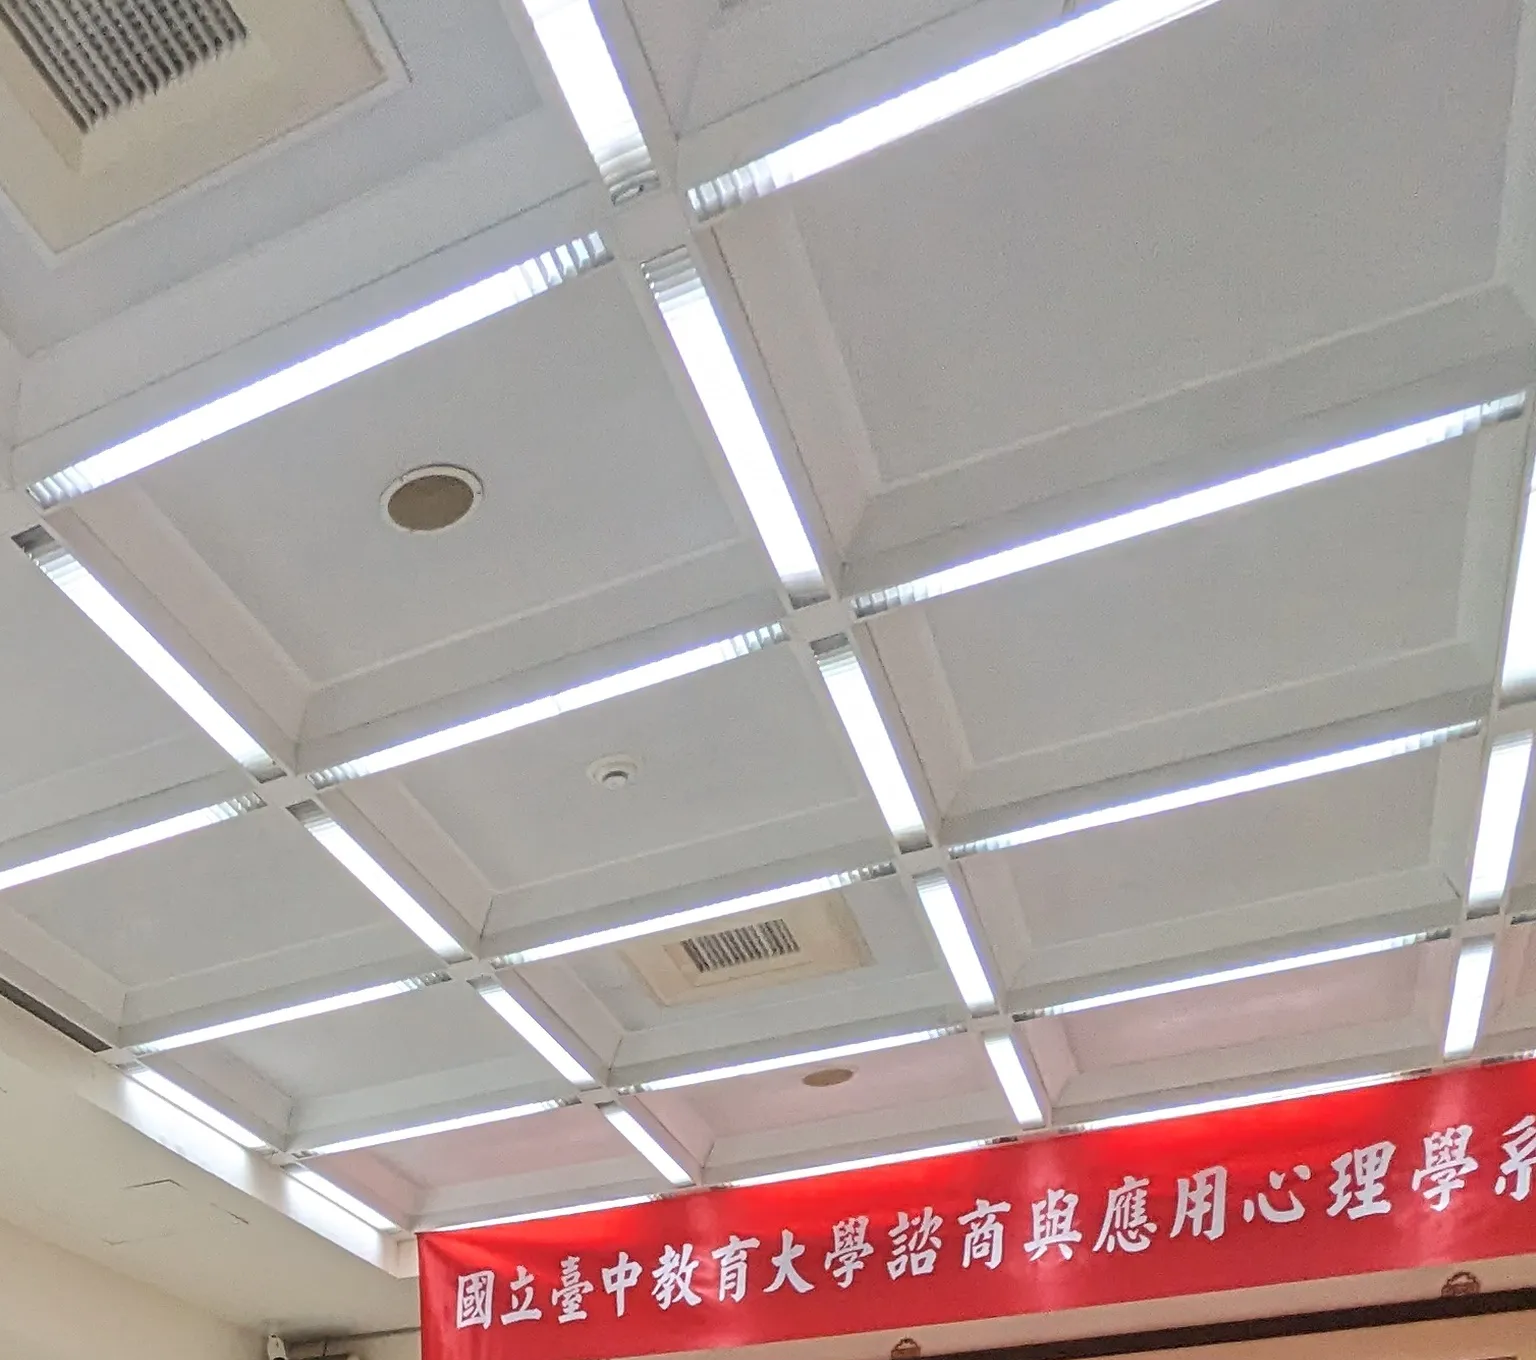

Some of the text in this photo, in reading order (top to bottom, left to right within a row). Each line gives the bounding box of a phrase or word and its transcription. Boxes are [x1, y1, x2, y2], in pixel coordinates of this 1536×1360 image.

[455, 1114, 1536, 1330] 國立臺中教育大學諮商與應用心理學系
